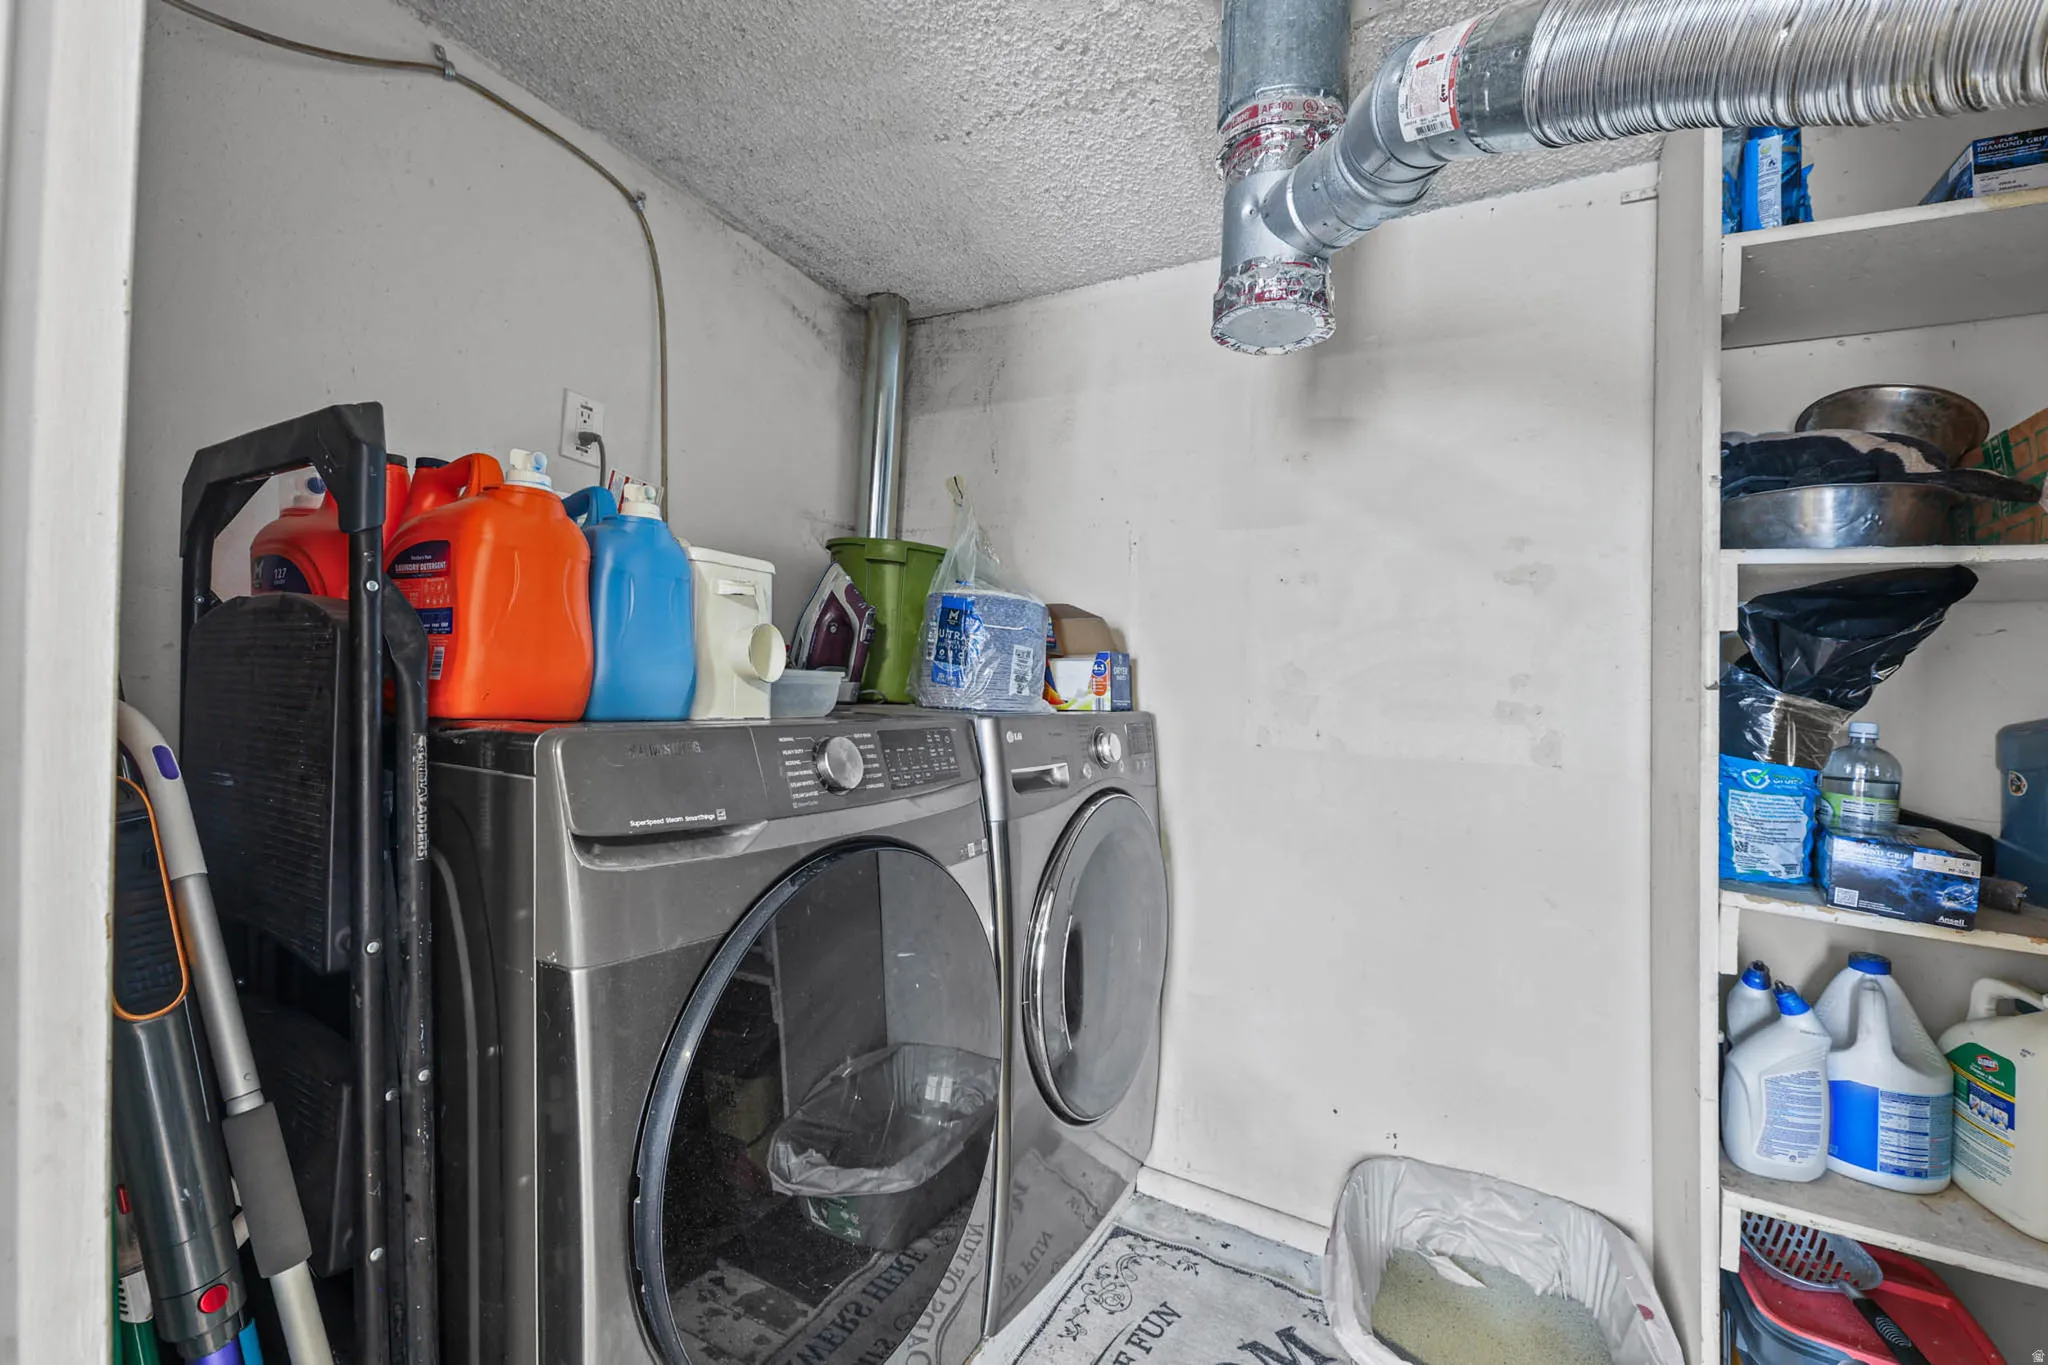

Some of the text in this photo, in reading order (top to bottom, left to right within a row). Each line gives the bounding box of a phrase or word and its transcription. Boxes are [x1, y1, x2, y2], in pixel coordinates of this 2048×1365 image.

[1977, 140, 2024, 152] DIAMOND
[420, 561, 446, 570] DETERGENT
[274, 567, 287, 579] 127
[416, 798, 428, 857] LADDERS
[1938, 915, 1965, 927] Ansell
[1124, 1301, 1183, 1356] FUN
